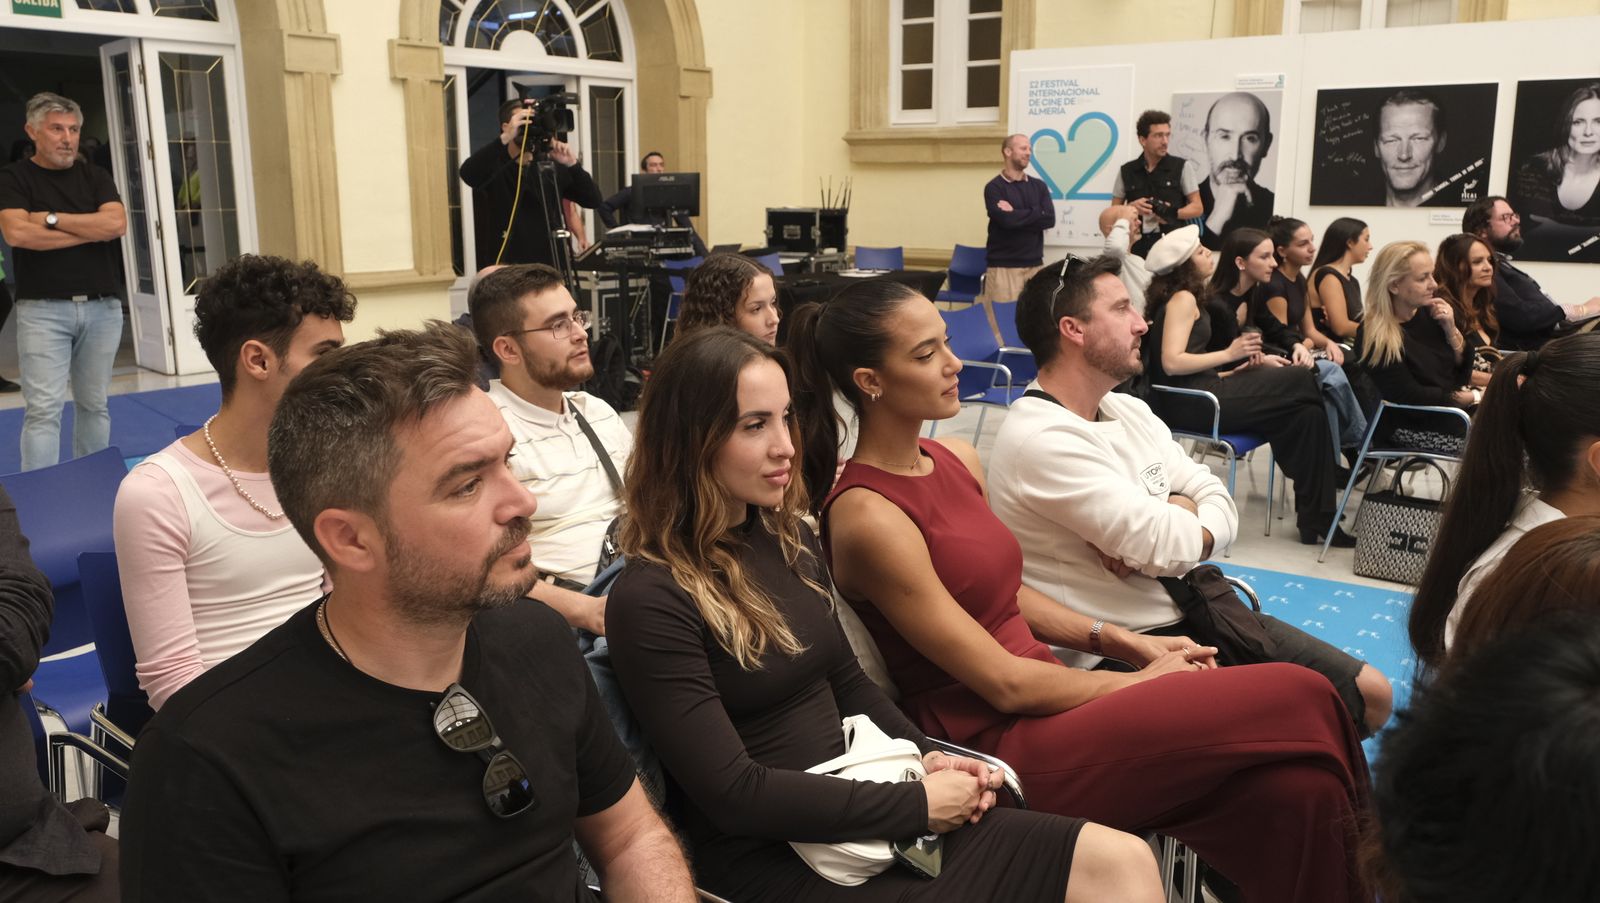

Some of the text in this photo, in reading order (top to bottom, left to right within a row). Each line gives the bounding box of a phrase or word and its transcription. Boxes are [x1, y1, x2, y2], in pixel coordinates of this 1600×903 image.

[1040, 79, 1079, 88] FESTIVAL
[1028, 88, 1100, 98] INTERNACIONAL
[1028, 99, 1040, 107] DE
[1041, 98, 1063, 106] CINE
[1063, 97, 1076, 105] DE
